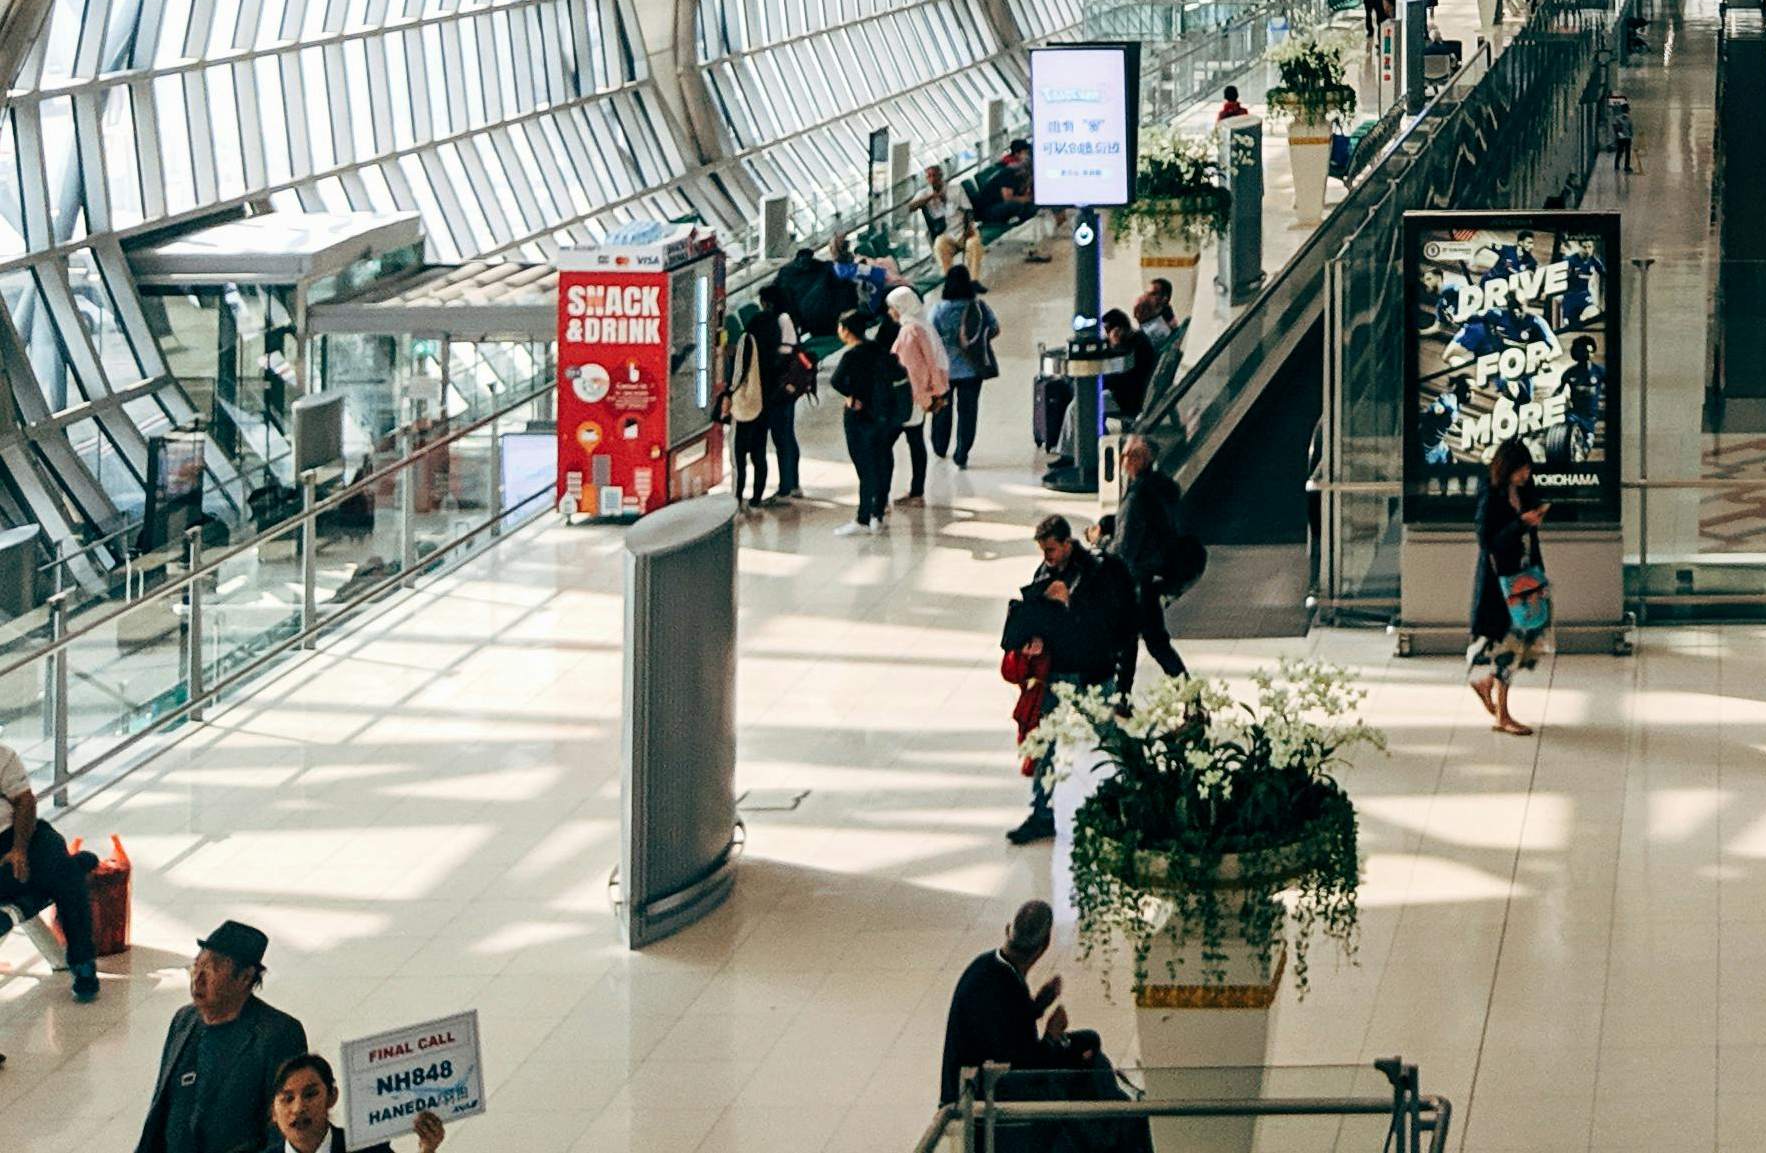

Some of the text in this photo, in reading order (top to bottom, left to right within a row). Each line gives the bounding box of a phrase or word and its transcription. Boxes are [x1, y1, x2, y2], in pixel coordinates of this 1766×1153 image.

[636, 255, 660, 265] VISA
[567, 285, 660, 317] SNACK
[1451, 261, 1569, 322] DRIVE
[566, 317, 661, 345] &DRINK
[1460, 396, 1567, 450] MORE
[1532, 473, 1600, 486] YOKOHAMA
[369, 1032, 455, 1063] FINAL CALL
[377, 1060, 454, 1095] NH848
